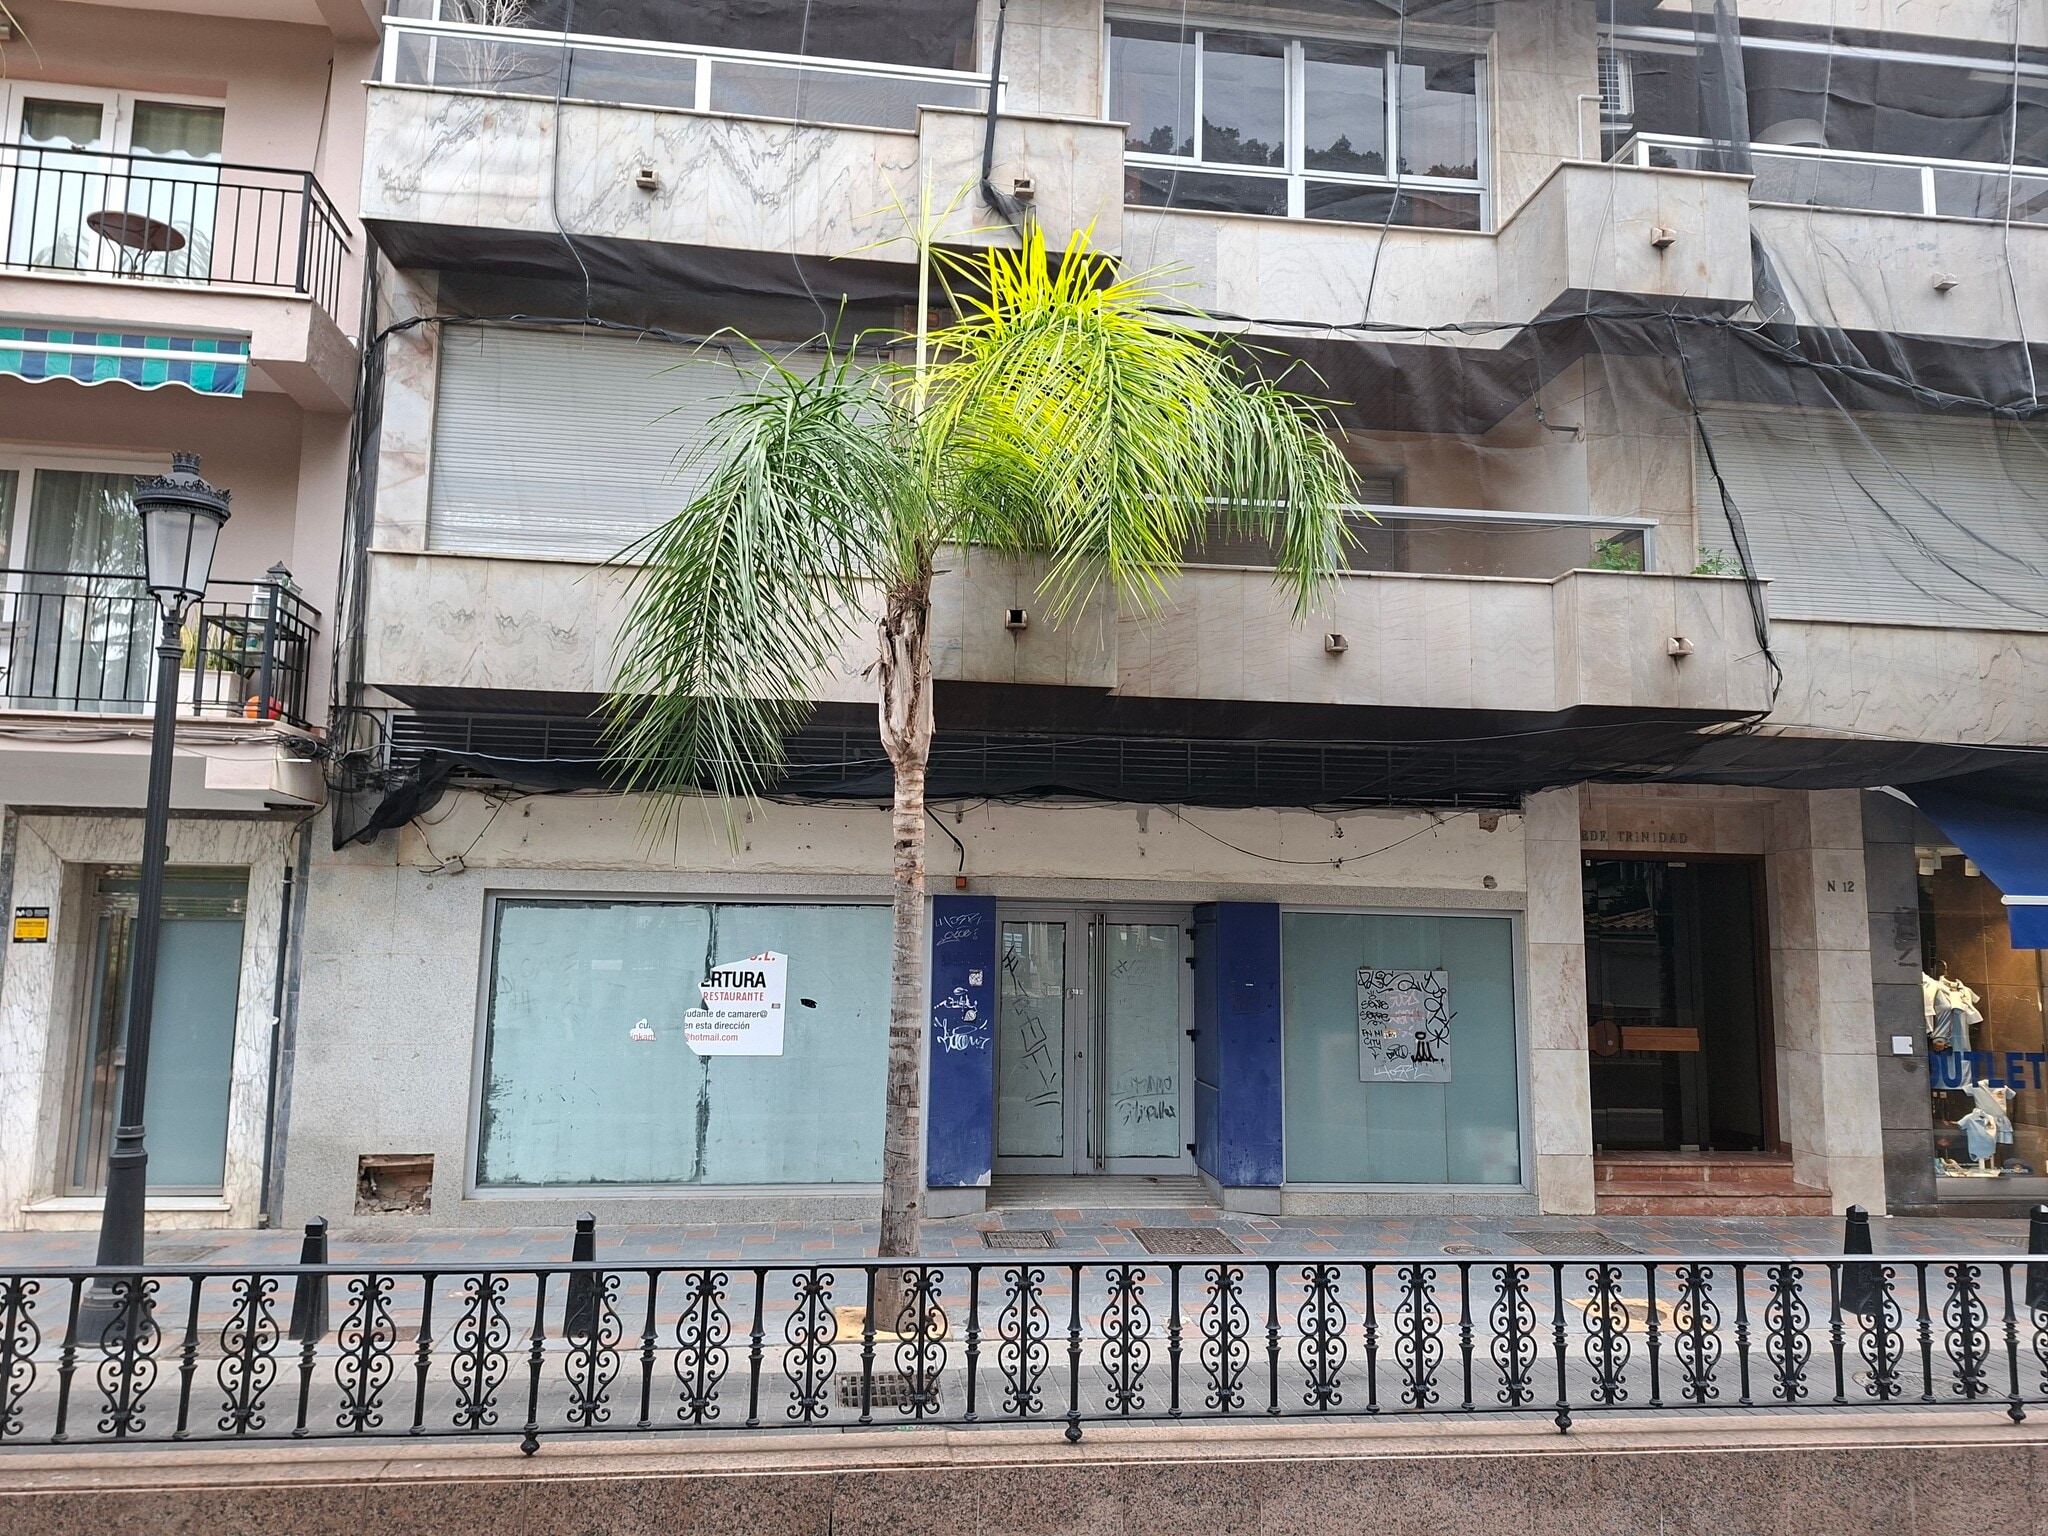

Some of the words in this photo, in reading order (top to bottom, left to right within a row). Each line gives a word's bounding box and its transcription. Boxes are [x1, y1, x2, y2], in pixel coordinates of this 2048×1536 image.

[1617, 831, 1688, 844] TRINIDAD
[1827, 880, 1836, 892] N
[1842, 880, 1855, 893] 12
[703, 991, 764, 1002] RESTAURANTE
[715, 1010, 726, 1018] de
[727, 1009, 768, 1019] camarer@
[695, 1022, 712, 1030] esta
[714, 1020, 750, 1030] dirección
